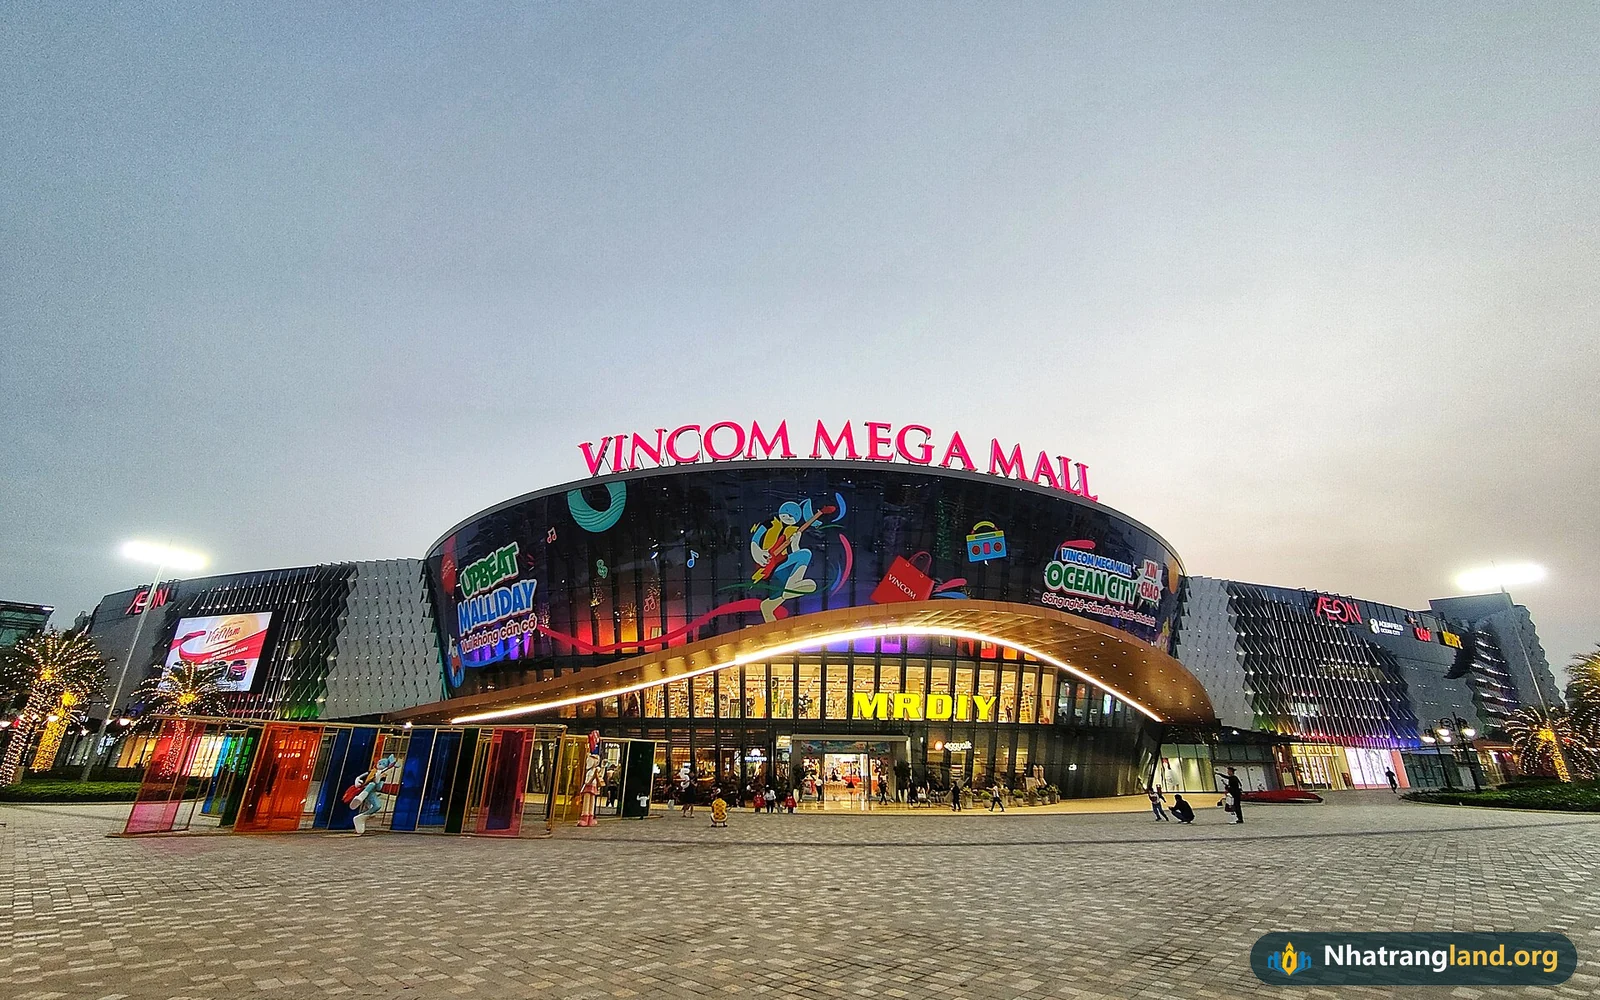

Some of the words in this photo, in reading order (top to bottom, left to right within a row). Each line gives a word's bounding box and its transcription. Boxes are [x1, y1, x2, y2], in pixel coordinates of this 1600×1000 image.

[577, 419, 797, 476] VINCOM
[808, 419, 978, 471] MEGA
[988, 438, 1098, 501] MALL
[461, 542, 519, 598] UPBEAT
[1044, 561, 1108, 600] OCEAN
[1107, 574, 1138, 604] CITY
[1062, 548, 1094, 567] VINCOM
[1094, 555, 1115, 572] MEGA
[458, 579, 537, 636] MALLIDAY
[889, 574, 917, 600] VINCOM
